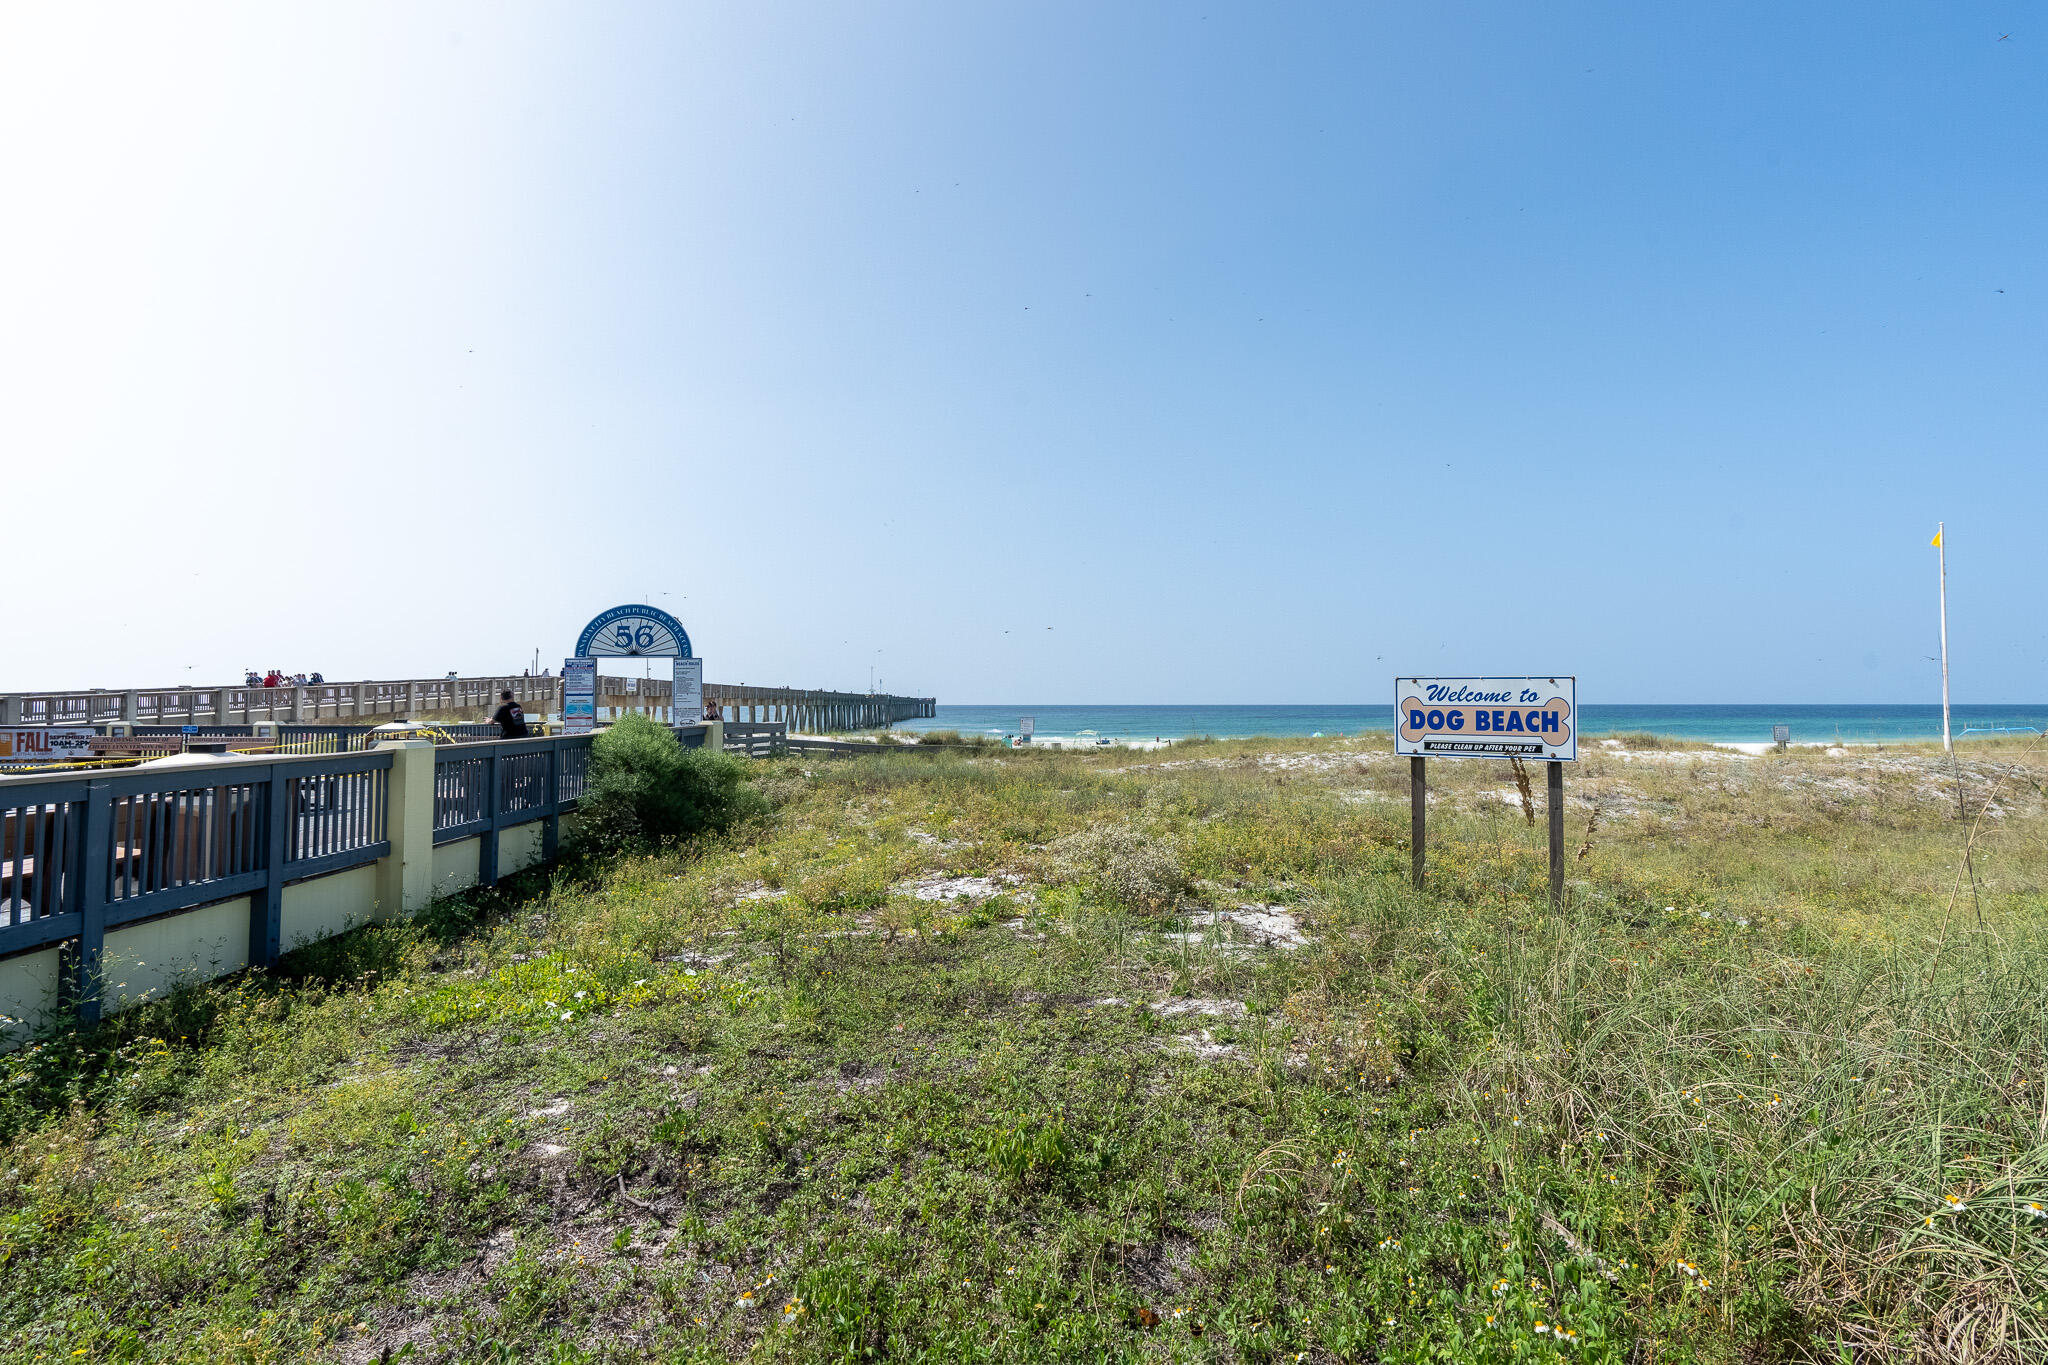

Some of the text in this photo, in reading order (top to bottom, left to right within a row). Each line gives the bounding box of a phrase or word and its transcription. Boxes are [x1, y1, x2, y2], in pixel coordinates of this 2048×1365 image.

[606, 607, 631, 619] BEACH
[632, 607, 657, 617] PUBLIC
[658, 613, 680, 632] BEACH
[678, 632, 690, 657] ACCESS
[615, 625, 654, 648] 56
[1426, 684, 1540, 703] Welcome to
[1409, 709, 1559, 733] DOG BEACH
[16, 731, 53, 752] FALL
[1430, 742, 1452, 750] PLEASE
[1453, 743, 1473, 751] CLEAN
[1484, 744, 1504, 752] AFTER
[1504, 744, 1523, 752] YOUR
